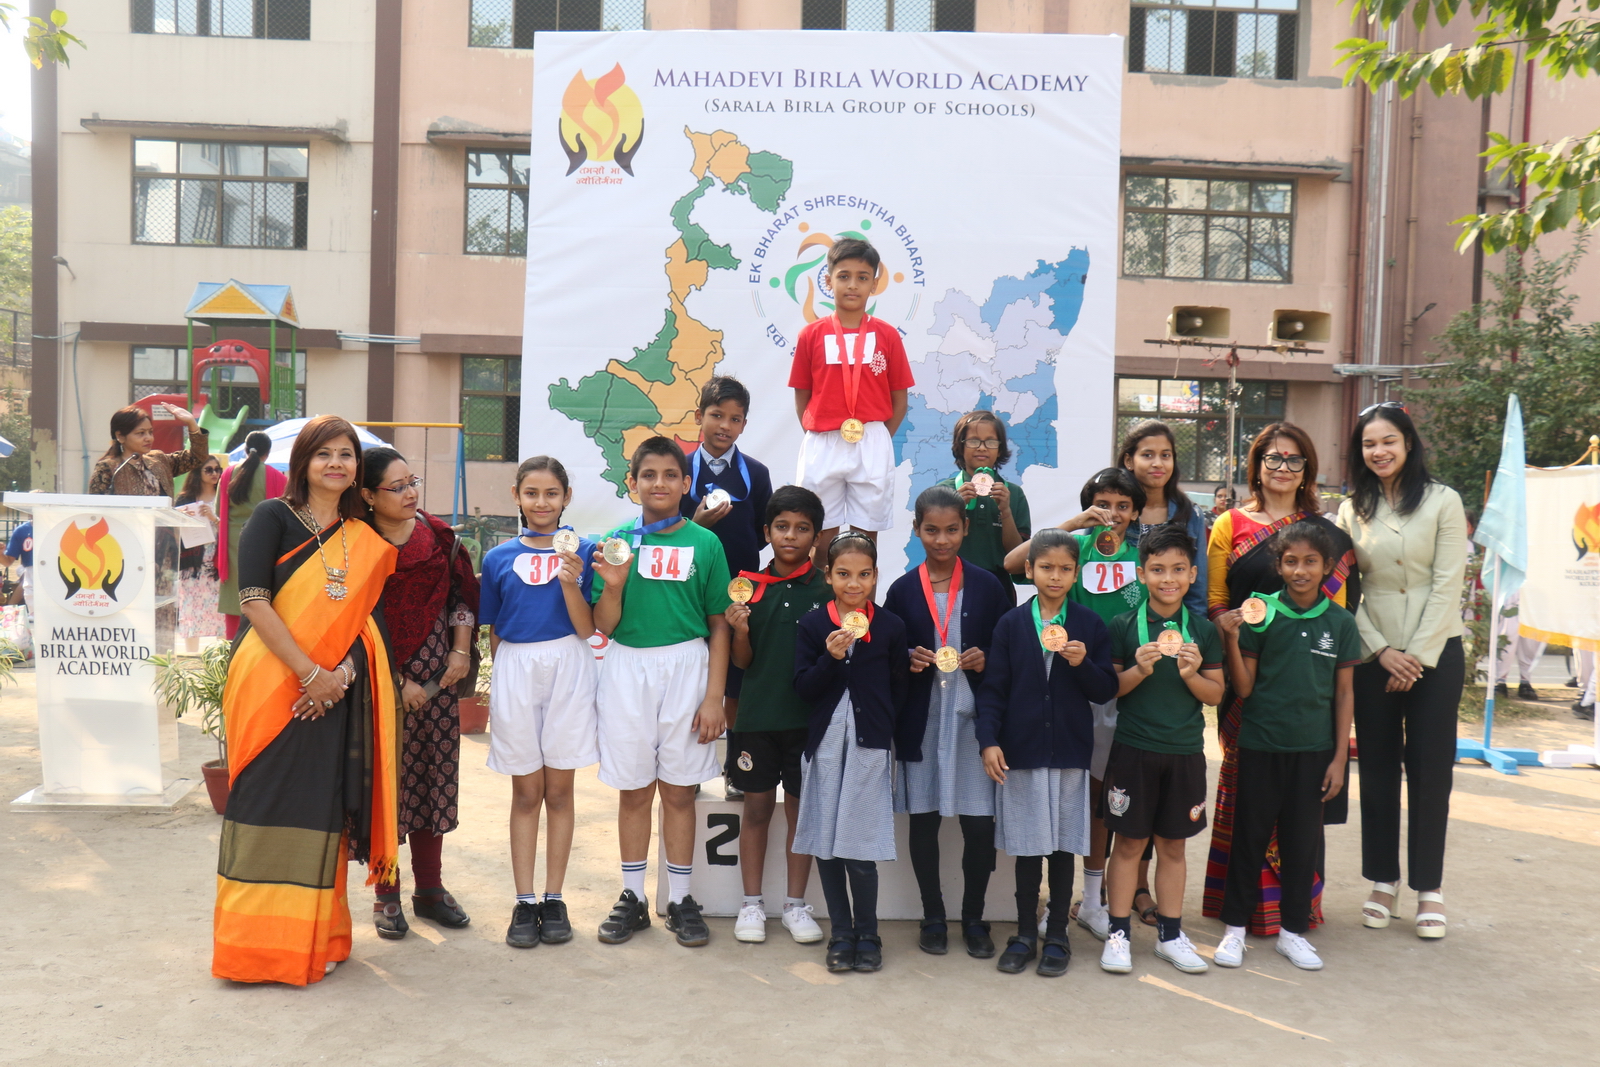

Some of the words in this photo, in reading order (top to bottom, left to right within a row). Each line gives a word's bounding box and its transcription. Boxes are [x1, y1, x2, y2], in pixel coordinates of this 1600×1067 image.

[653, 68, 783, 88] MAHADEVI
[793, 68, 863, 88] BIRLA
[869, 68, 963, 90] WORLD
[970, 71, 1090, 92] ACADEMY
[704, 98, 776, 114] (SARALA
[783, 99, 836, 114] BIRLA
[842, 99, 906, 114] GROUP
[913, 101, 937, 115] OF
[945, 100, 1036, 118] SCHOOLS)
[803, 194, 896, 227] SHRESHTHA
[754, 205, 801, 259] BHARAT
[894, 224, 926, 287] BHARAT
[749, 262, 763, 284] EK
[651, 547, 681, 579] 34
[1095, 563, 1125, 592] 26
[51, 627, 136, 642] MAHADEVI
[40, 644, 88, 659] BIRLA
[91, 644, 150, 660] WORLD
[56, 661, 132, 676] ACADEMY
[705, 813, 741, 866] 2
